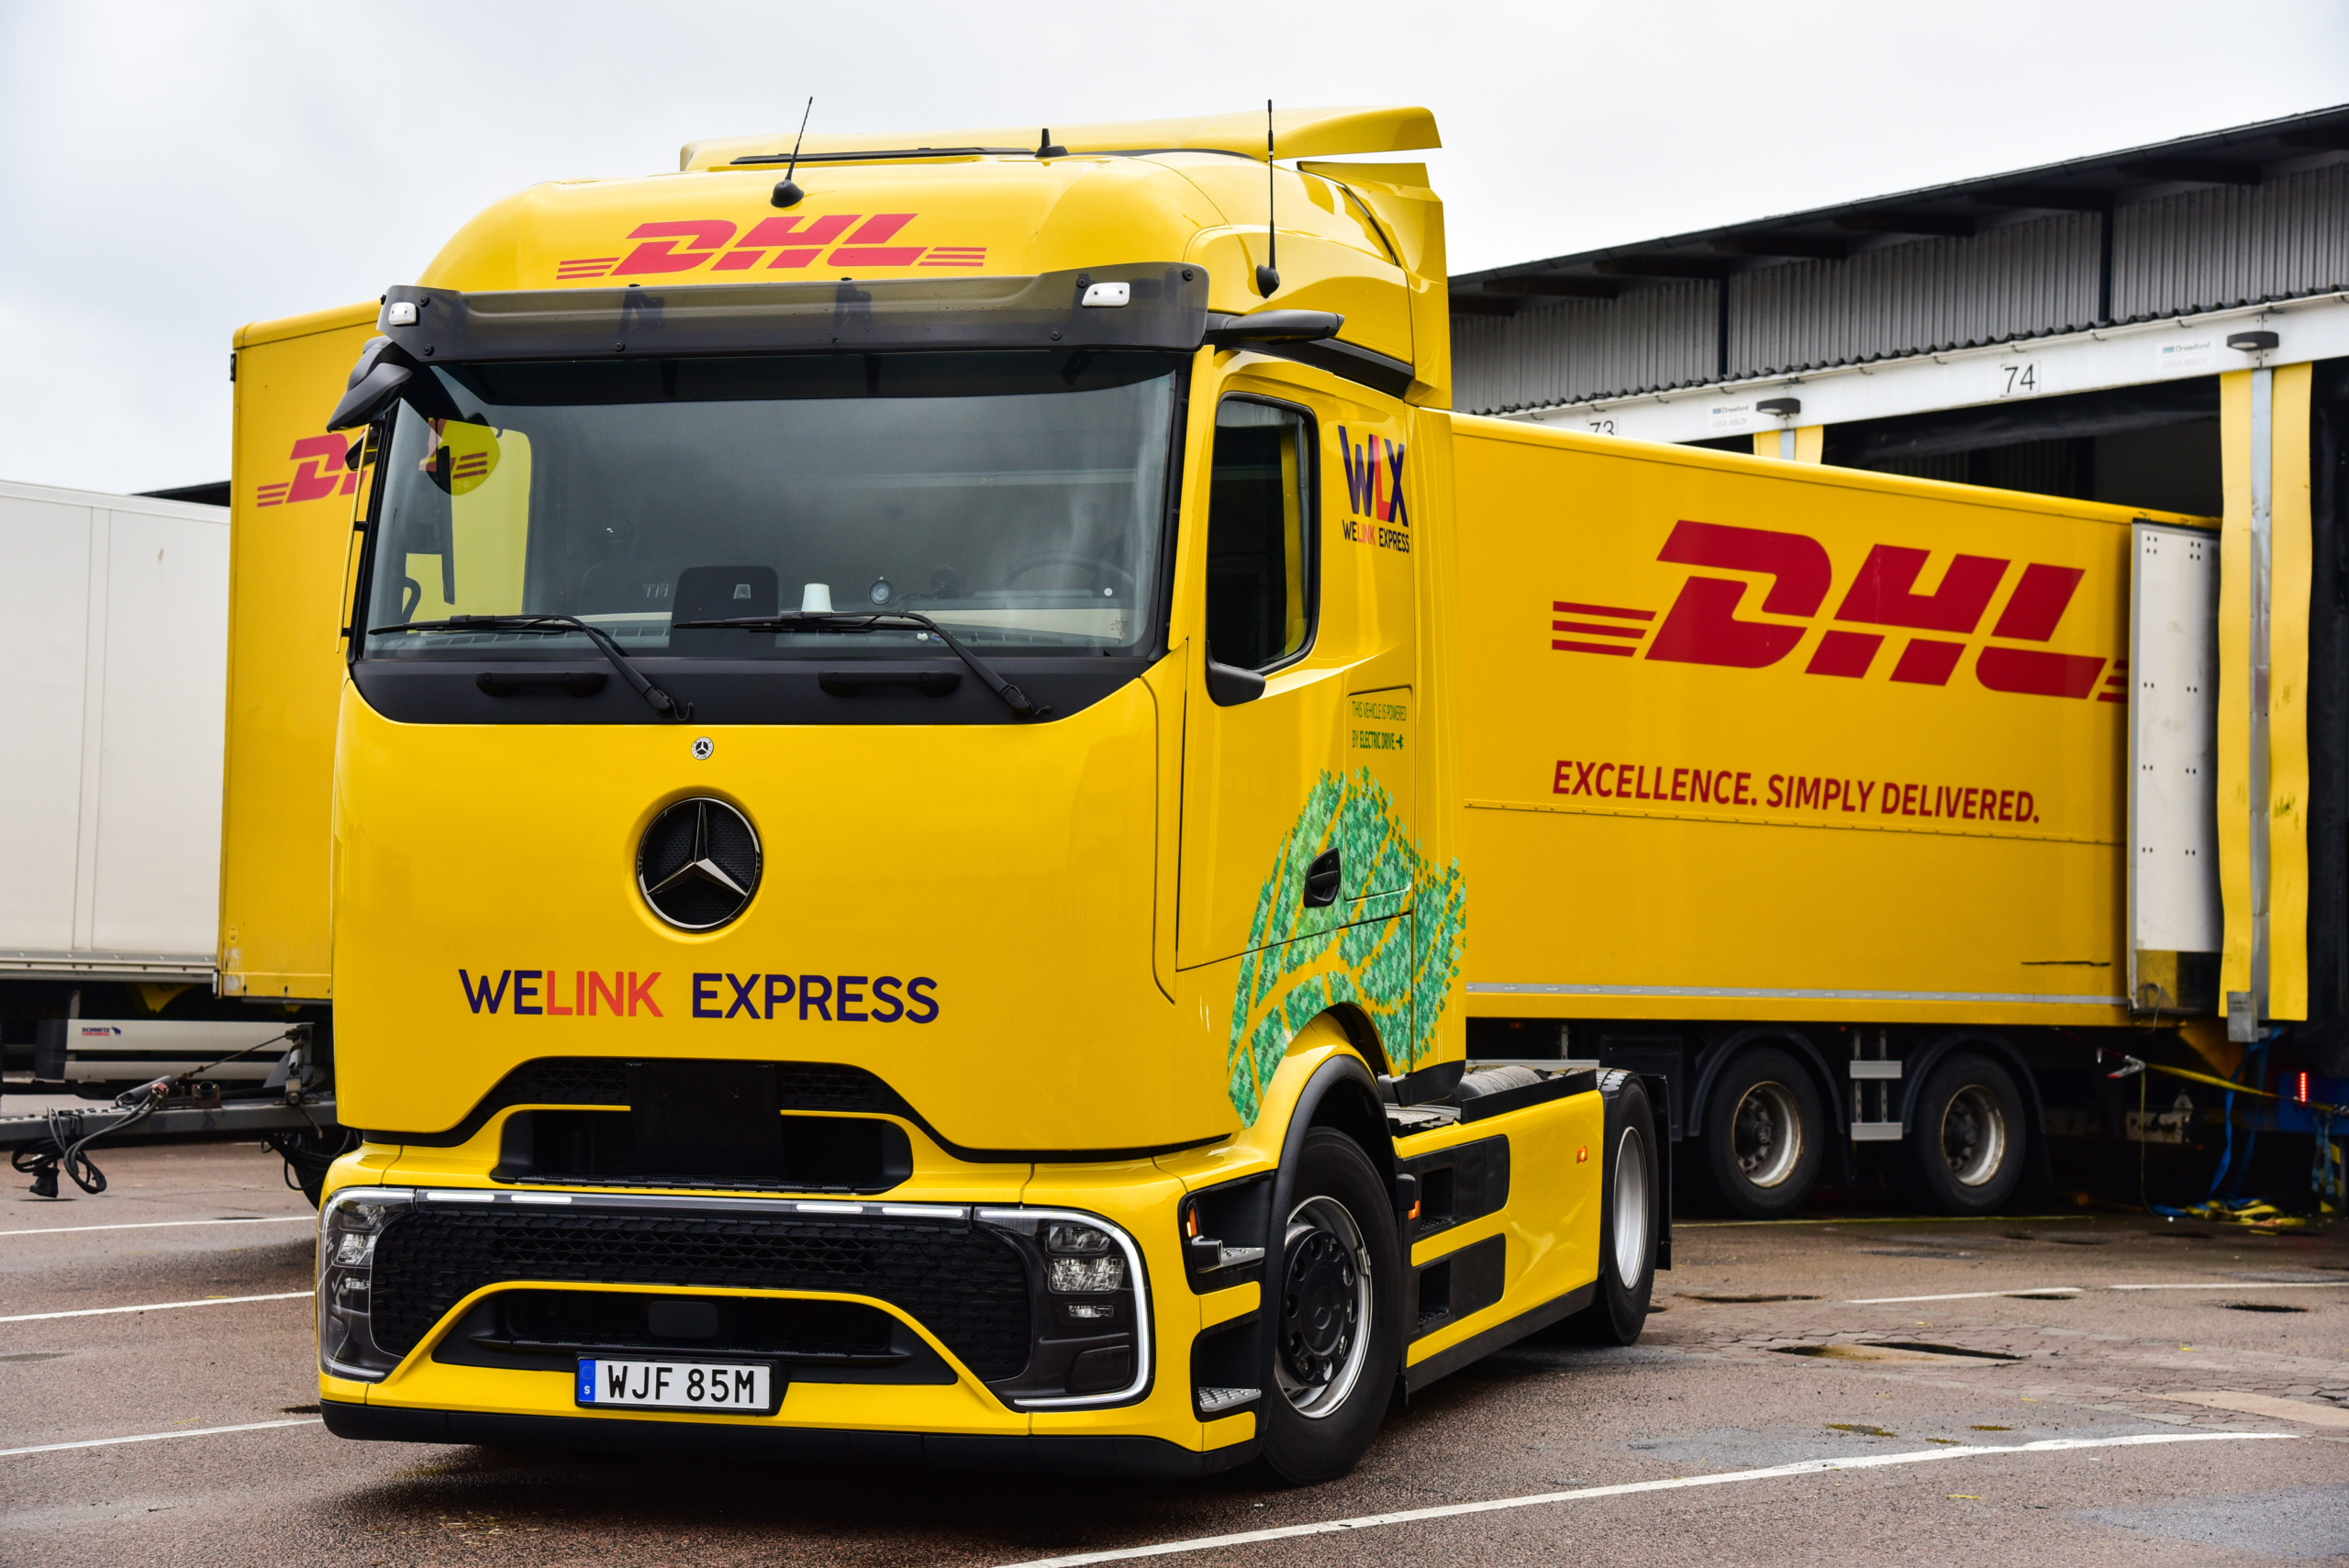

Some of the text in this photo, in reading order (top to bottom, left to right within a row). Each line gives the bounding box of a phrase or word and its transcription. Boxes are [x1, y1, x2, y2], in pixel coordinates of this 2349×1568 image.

[609, 213, 930, 276] DHL
[2004, 363, 2035, 394] 74
[1589, 420, 1614, 436] 73
[1338, 425, 1408, 528] WLX
[1342, 519, 1409, 553] WELINK EXPRESS
[1644, 519, 2107, 700] DHL
[1353, 701, 1362, 717] THIS
[1364, 702, 1381, 719] VEHICLE
[1386, 704, 1407, 721] POWERED
[1353, 730, 1359, 748] BY
[1360, 730, 1381, 750] ELECTRIC
[1553, 760, 2040, 824] EXCELLENCE. SIMPLY DELIVERED.
[458, 969, 940, 1024] WELINK EXPRESS
[584, 1385, 591, 1395] S
[607, 1364, 754, 1404] WJF 85M
